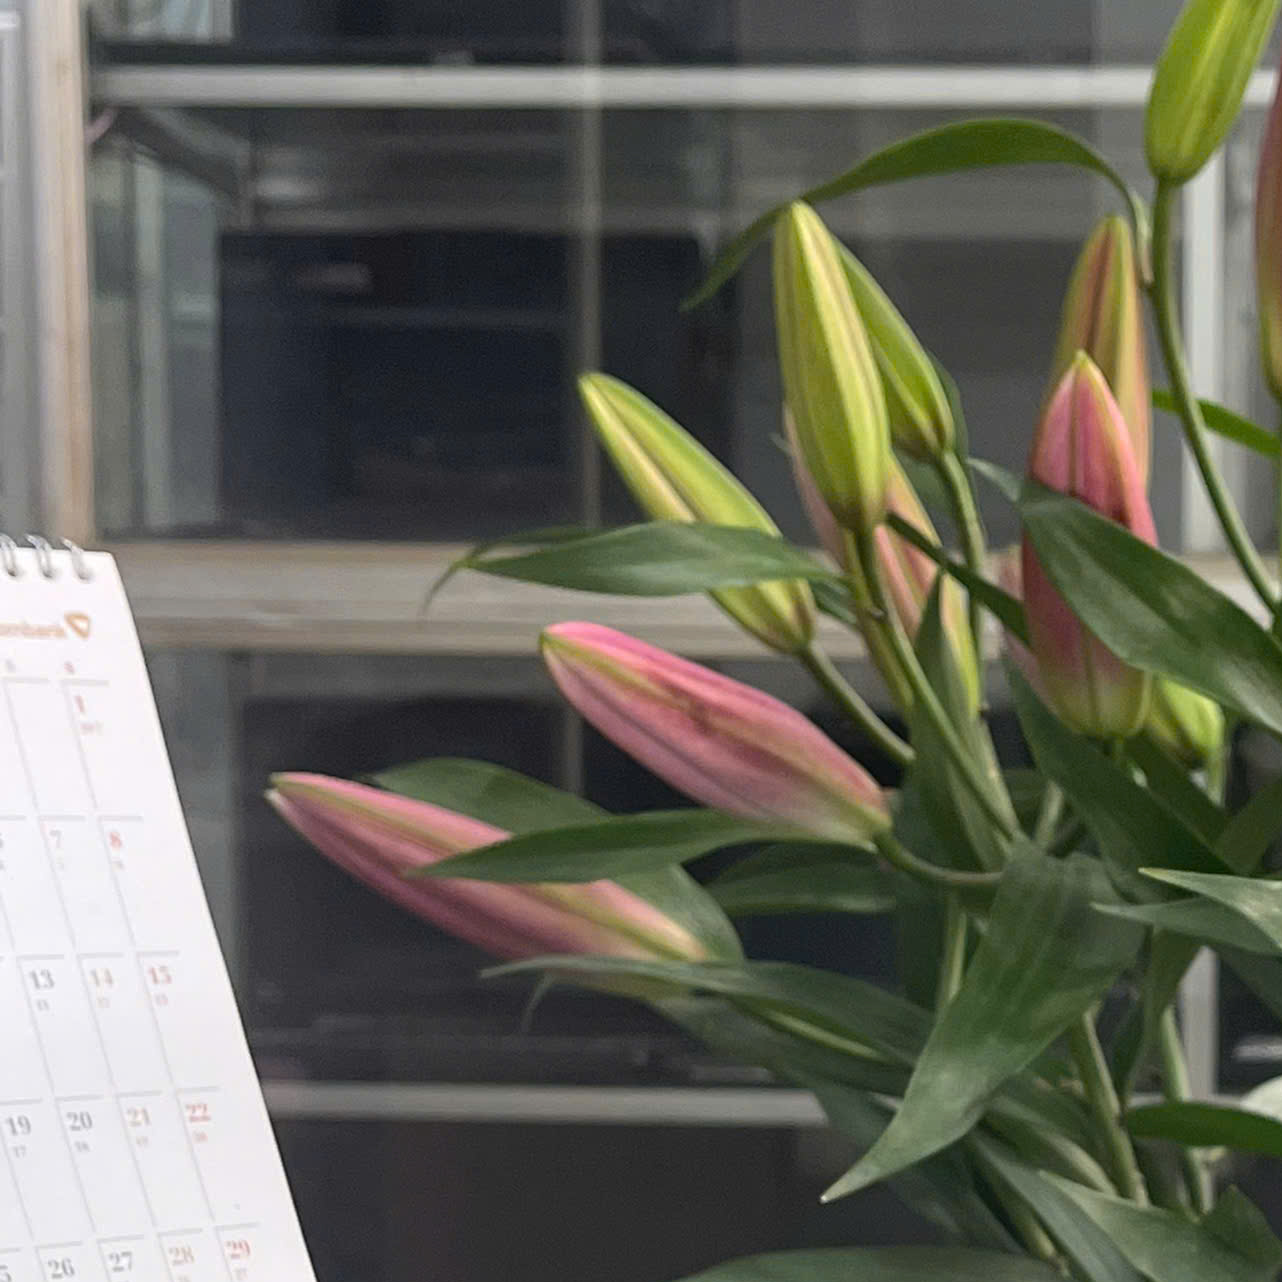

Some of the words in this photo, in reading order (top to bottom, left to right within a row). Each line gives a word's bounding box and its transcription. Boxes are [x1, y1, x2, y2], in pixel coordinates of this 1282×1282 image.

[29, 968, 55, 990] 13
[90, 967, 114, 988] 14
[6, 1115, 32, 1137] 19
[66, 1111, 94, 1132] 20
[127, 1107, 151, 1128] 21
[185, 1102, 212, 1124] 22
[47, 1257, 76, 1280] 26
[109, 1250, 134, 1273] 27
[168, 1245, 195, 1267] 28
[226, 1239, 251, 1260] 29
